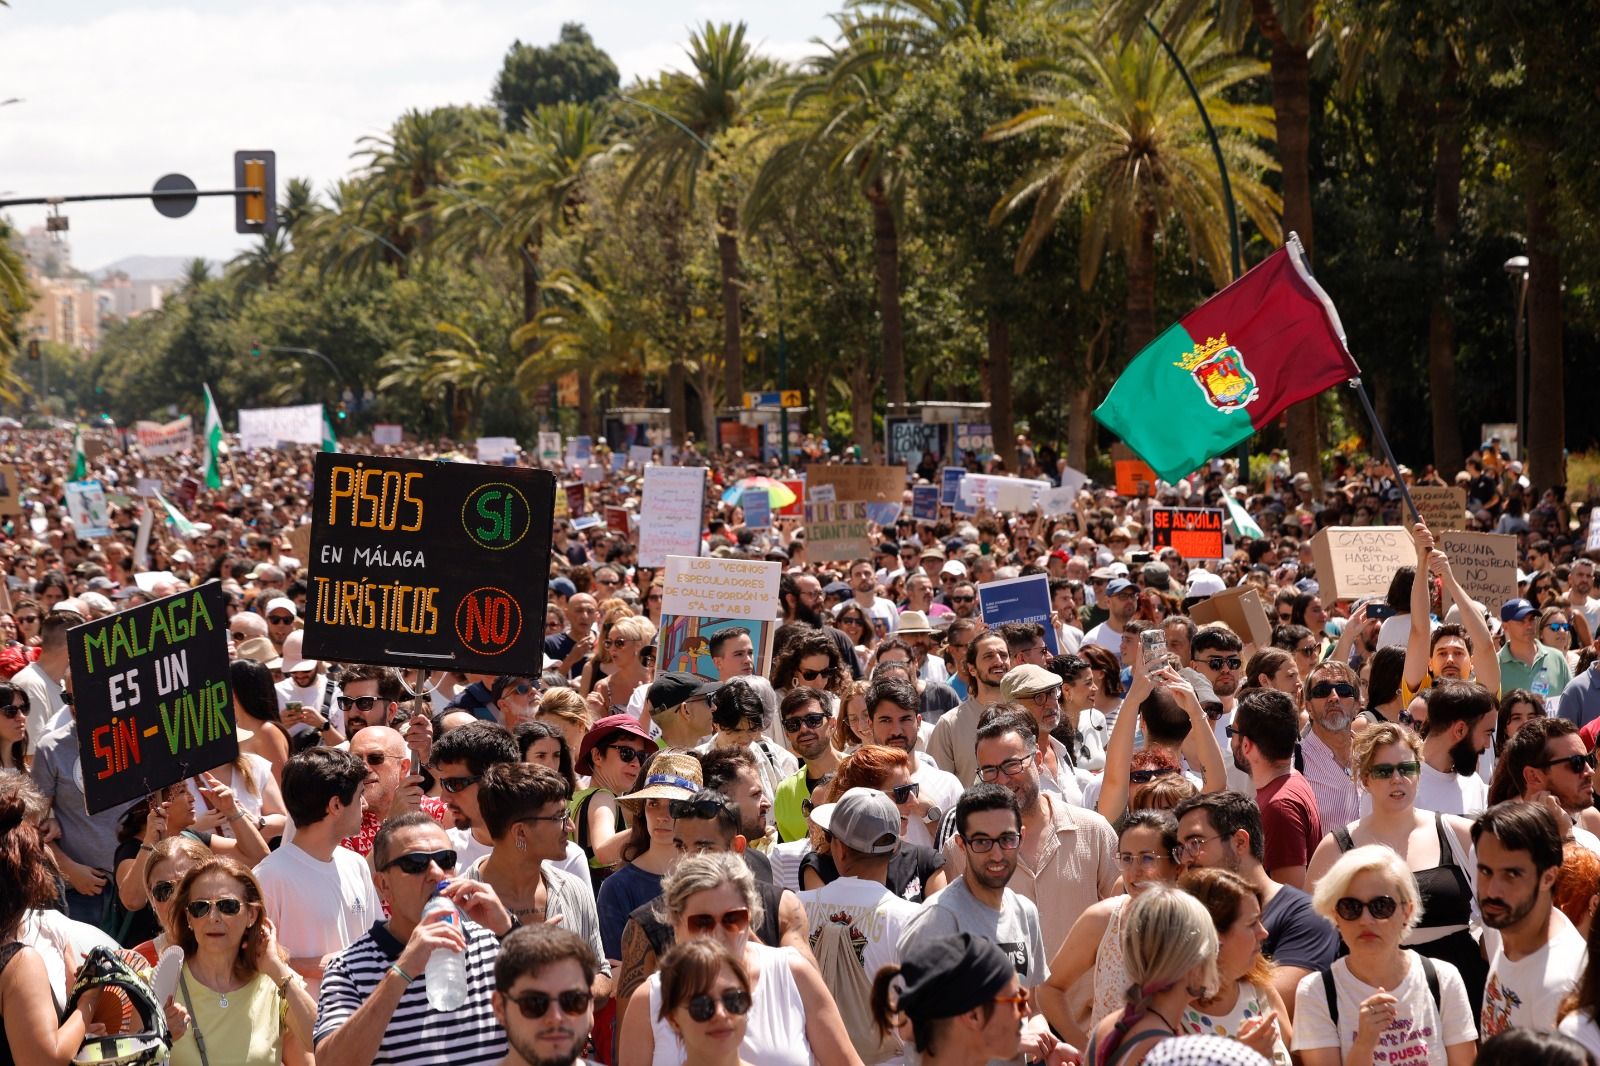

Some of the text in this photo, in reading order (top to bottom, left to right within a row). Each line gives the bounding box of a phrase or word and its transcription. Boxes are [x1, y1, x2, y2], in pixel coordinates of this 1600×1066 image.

[895, 424, 937, 440] BARCE
[328, 462, 424, 531] PISOS
[1154, 511, 1220, 529] SE ALQUILA
[1338, 533, 1397, 547] CASAS
[320, 544, 425, 568] EN MÁLAGA
[690, 560, 711, 570] LOS
[1362, 564, 1383, 573] NO
[676, 573, 766, 589] ESPECULADORES
[1466, 568, 1488, 581] NO
[664, 586, 680, 597] DE
[680, 588, 717, 600] CALLE
[716, 590, 758, 602] GORDÓN
[313, 576, 510, 645] TURÍSTICOS NO
[83, 591, 214, 674] MÁLAGA
[108, 649, 190, 713] ES UN
[1389, 1044, 1429, 1065] pussy
